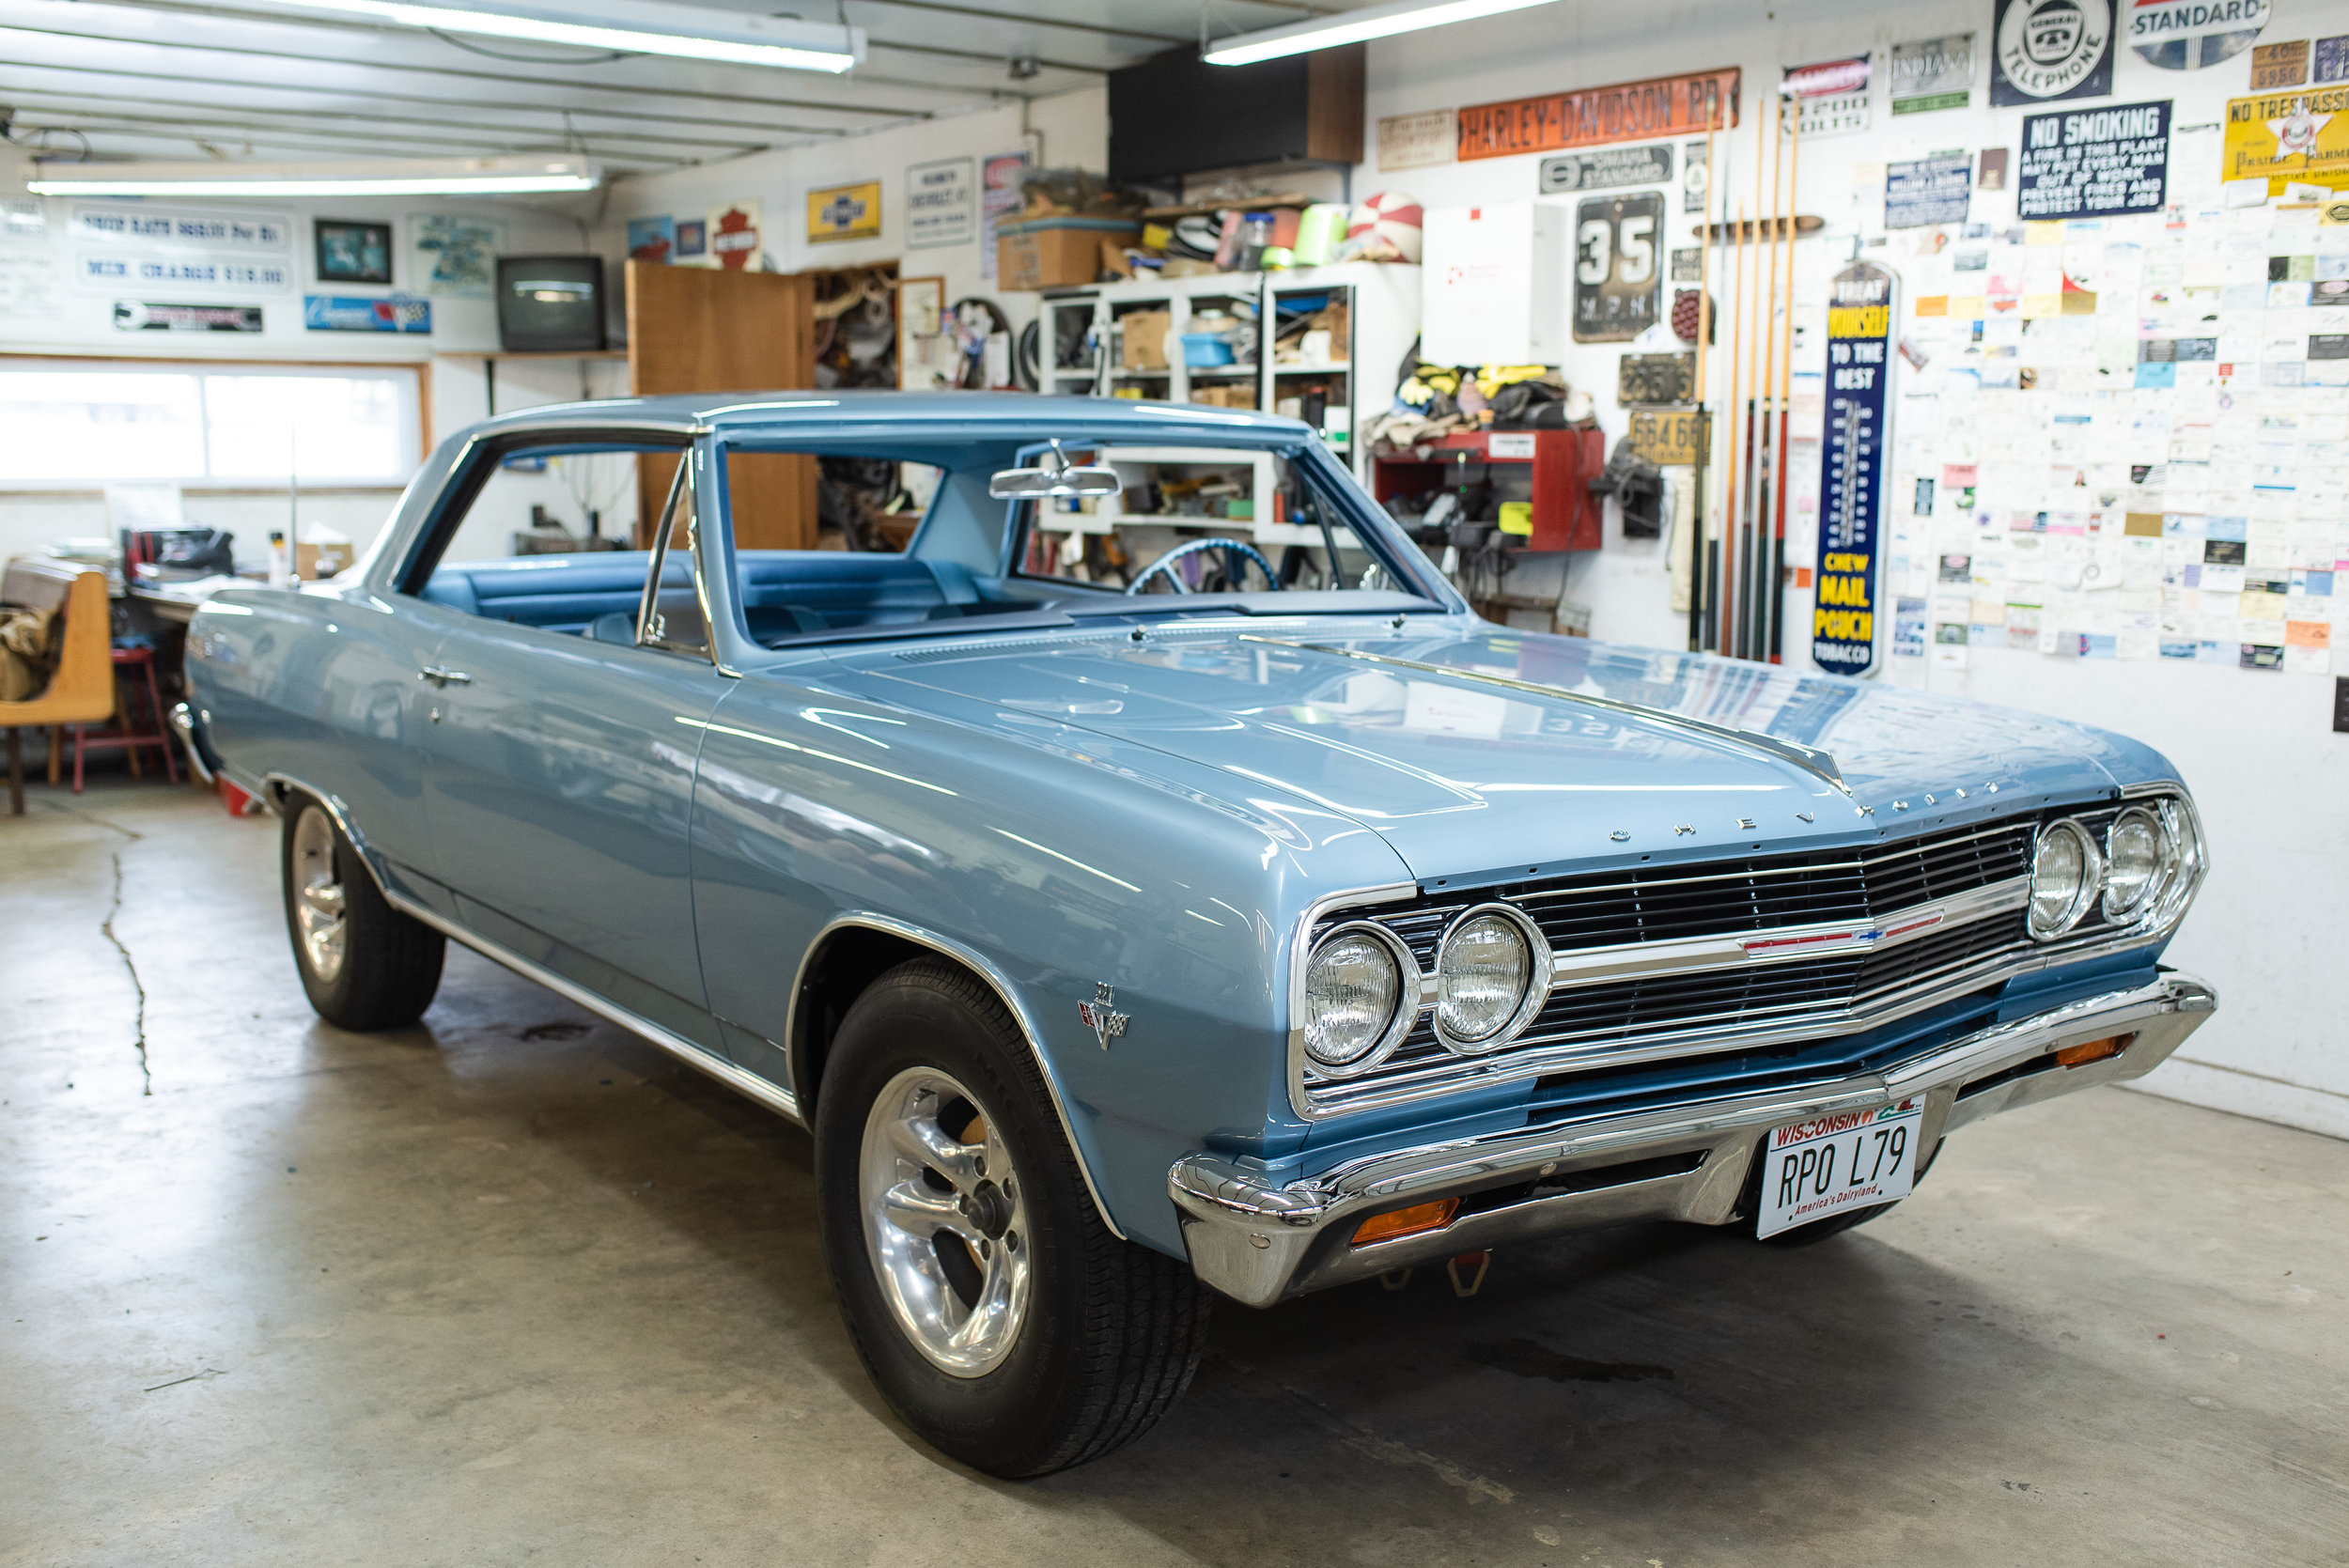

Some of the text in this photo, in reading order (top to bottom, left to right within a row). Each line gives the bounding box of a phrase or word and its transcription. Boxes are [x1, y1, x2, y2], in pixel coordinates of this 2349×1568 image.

[2135, 0, 2260, 35] STANDARD
[2007, 34, 2101, 88] TELEPHONE
[1462, 81, 1673, 153] HARLEY-DAVIDSON
[2030, 106, 2160, 149] NO SMOKING
[2231, 103, 2252, 122] NO
[2021, 137, 2167, 164] A FIRE IN THIS PLANT
[2021, 151, 2165, 178] MAY PUT EVERY MAN
[2021, 178, 2162, 202] PREVENT FIRES AND
[2036, 165, 2146, 189] OUT OF WORK
[2021, 192, 2159, 215] PROTECT YOUR JOB
[1578, 215, 1655, 286] 35
[1837, 279, 1884, 303] TREAT
[1828, 303, 1890, 339] YOURSELF
[1830, 341, 1885, 365] TO THE
[1834, 367, 1875, 390] BEST
[1824, 551, 1870, 573] CHEW
[1819, 575, 1870, 608] MAIL
[1814, 608, 1873, 642] POUCH
[1813, 642, 1870, 664] TOBACCO
[1777, 1111, 1861, 1147] WISCONSIN
[1777, 1126, 1907, 1209] RPO L79
[1794, 1183, 1878, 1217] America's Dairyland
